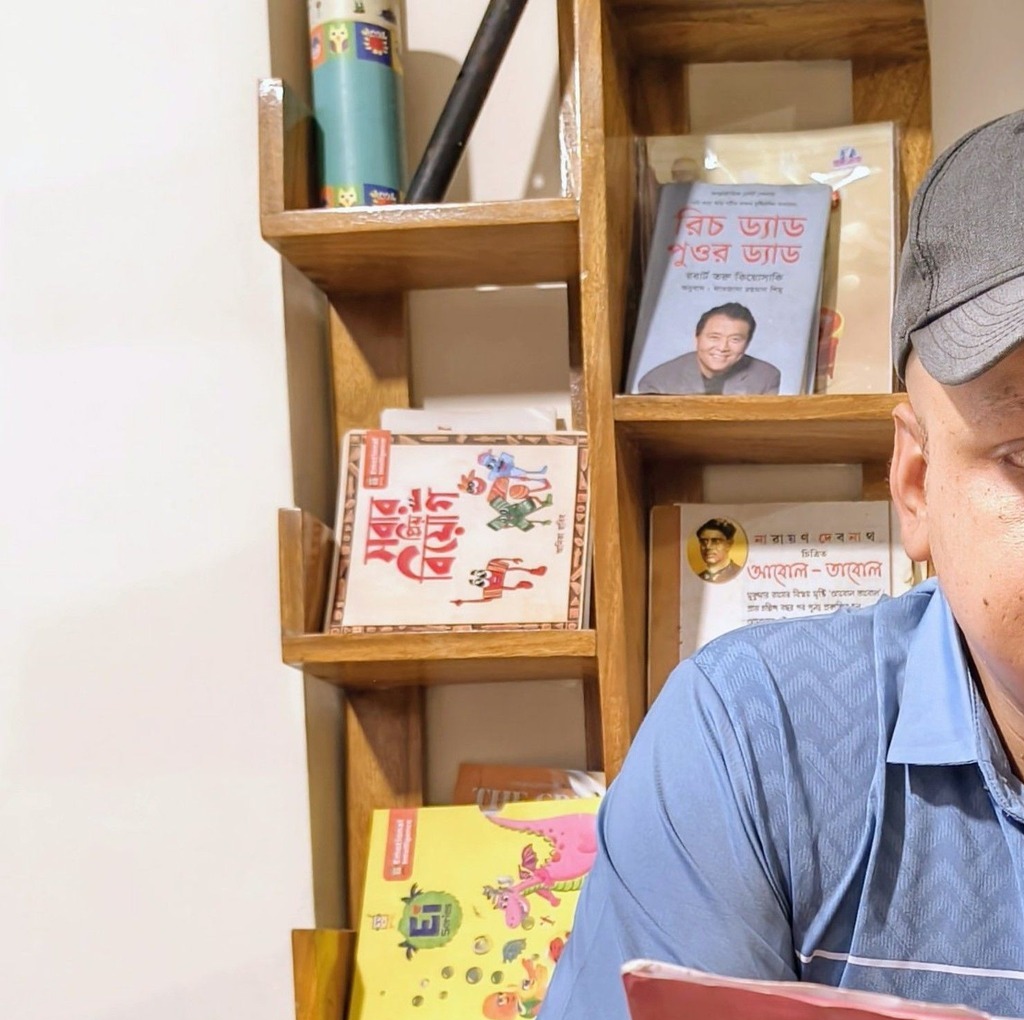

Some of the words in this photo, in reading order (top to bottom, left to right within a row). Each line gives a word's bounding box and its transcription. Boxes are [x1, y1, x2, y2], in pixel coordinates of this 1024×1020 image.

[674, 207, 727, 237] রিচ
[738, 214, 808, 239] ড্যাড
[667, 241, 733, 267] পুওর
[741, 243, 803, 266] ড্যাড
[364, 496, 408, 566] সবার
[397, 486, 466, 584] বিয়োগ
[747, 562, 809, 587] আবোল
[825, 560, 883, 585] তাবোল
